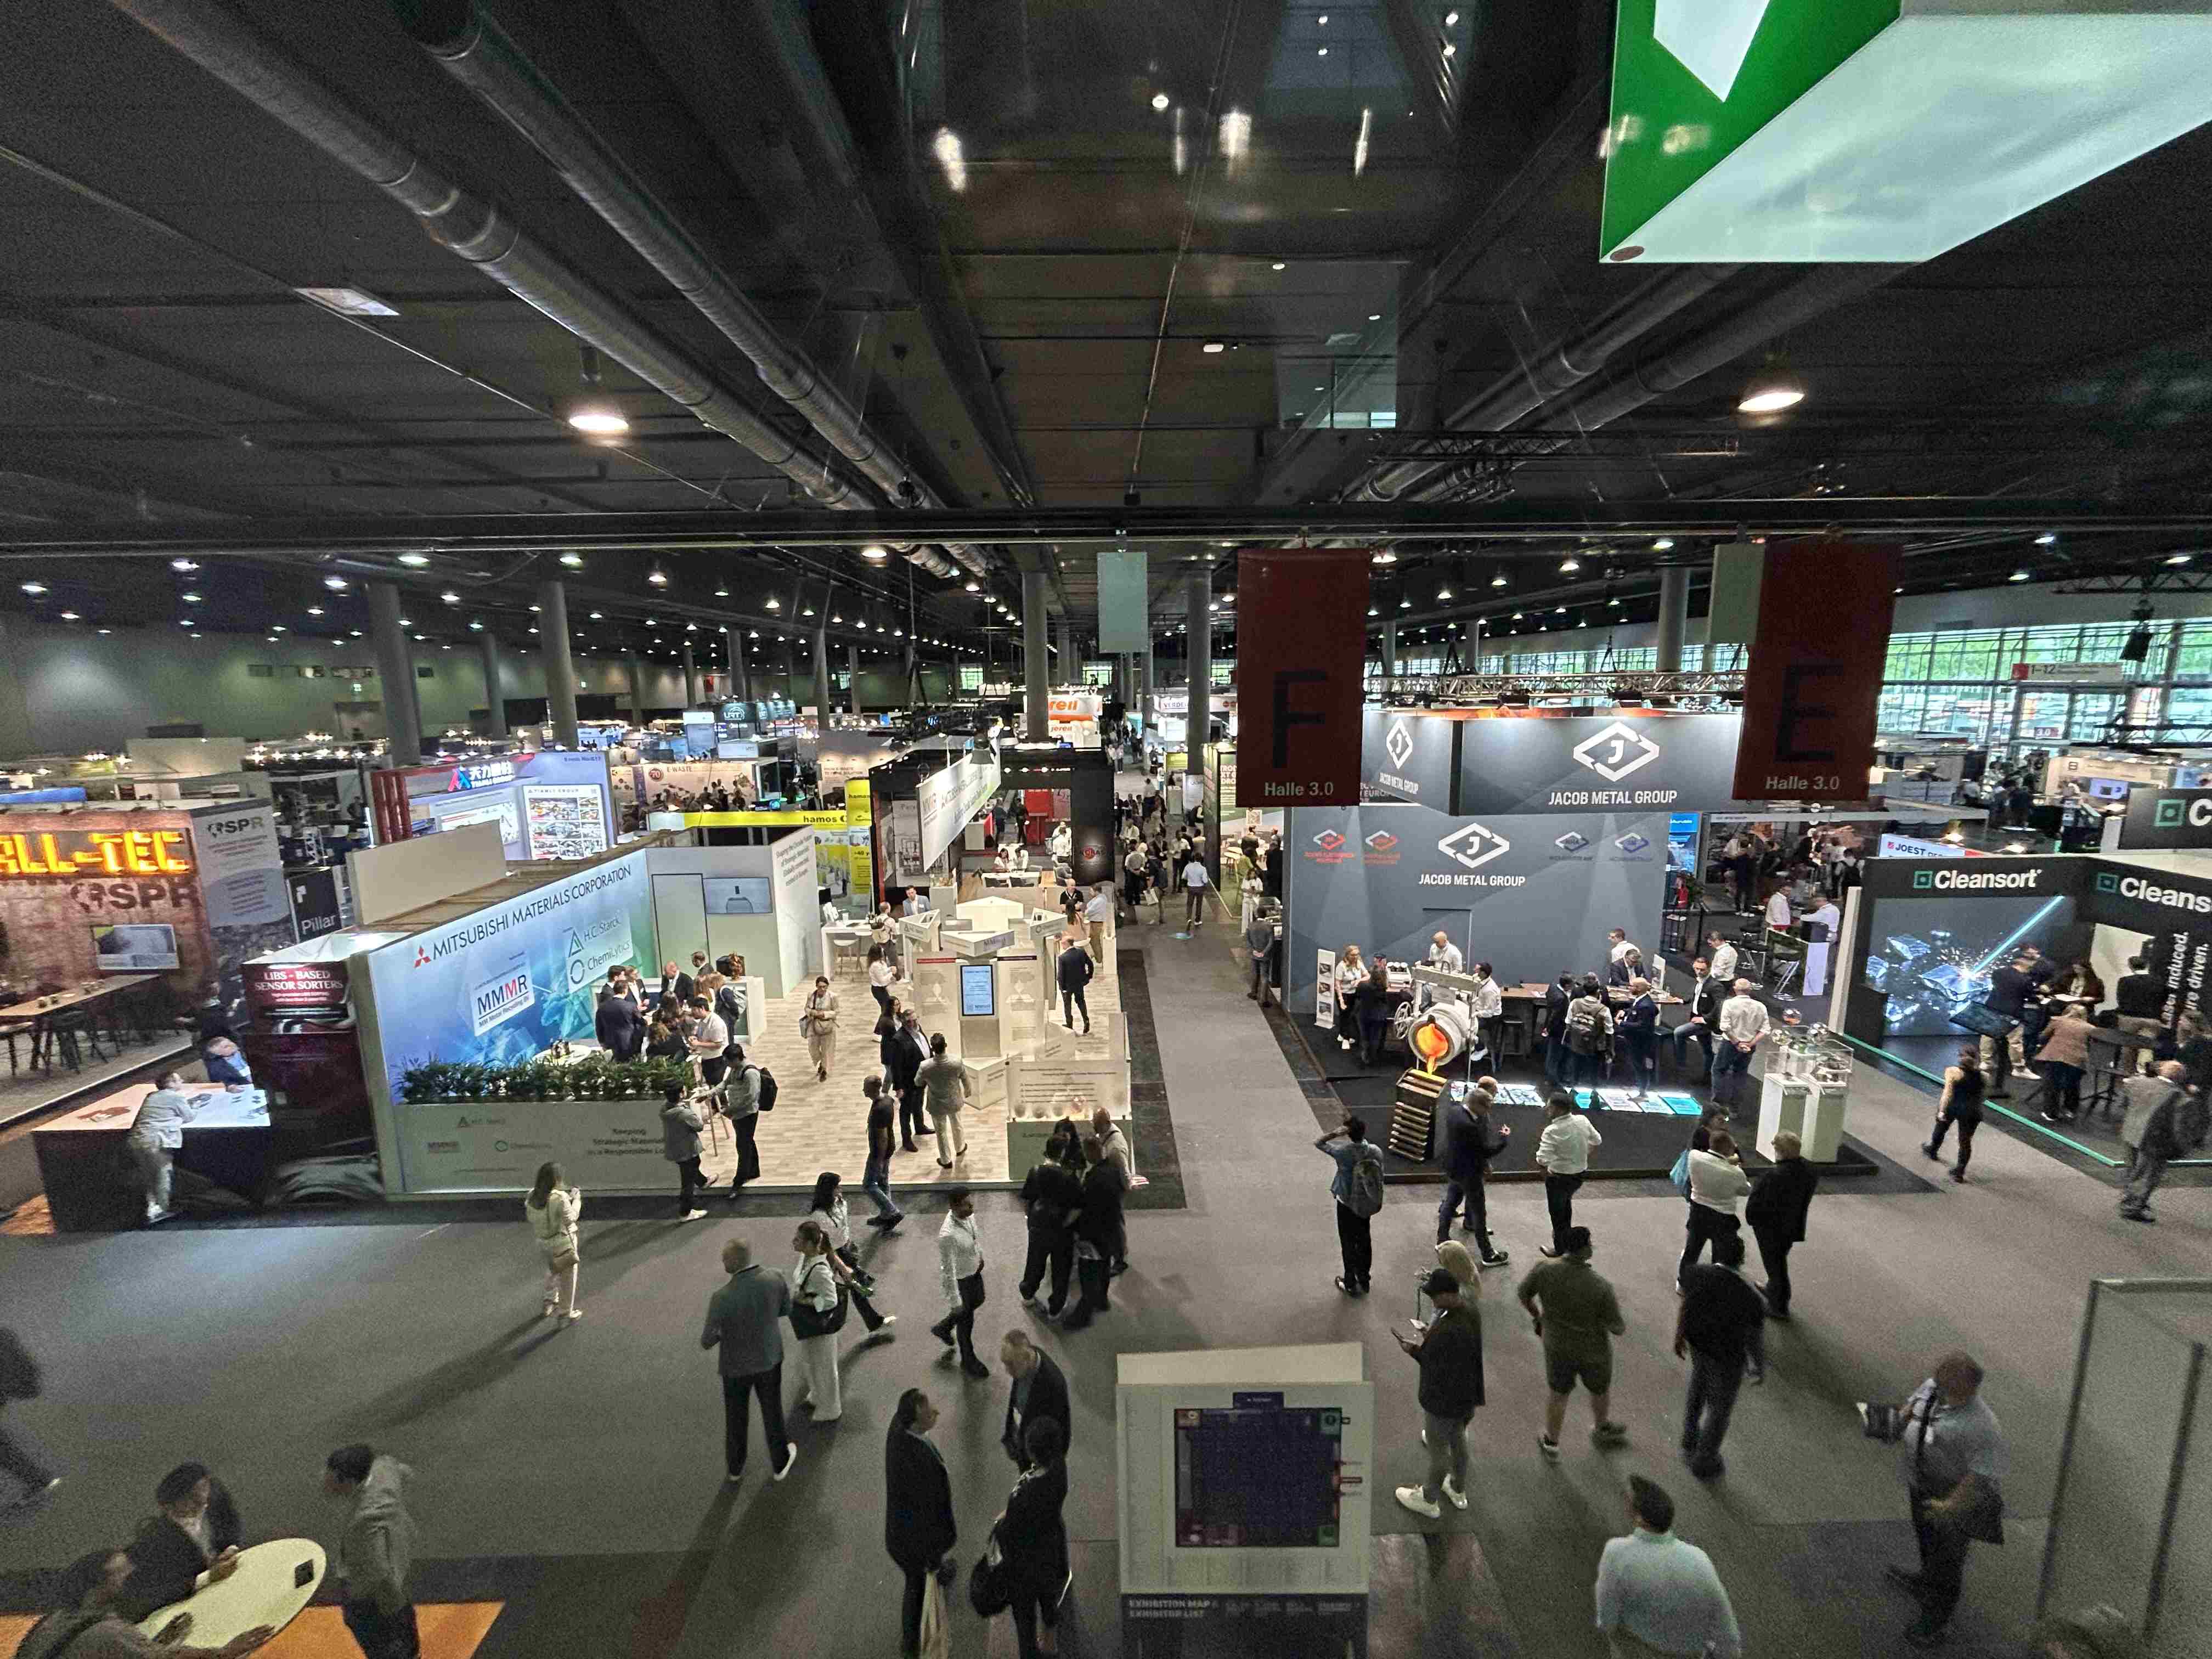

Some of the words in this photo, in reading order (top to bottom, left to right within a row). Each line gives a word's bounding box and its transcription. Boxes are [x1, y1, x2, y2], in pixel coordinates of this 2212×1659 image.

[1272, 669, 1327, 769] F
[1773, 661, 1844, 763] E
[1264, 781, 1304, 797] Halle
[1308, 781, 1334, 796] 3.0
[1379, 772, 1391, 786] JACOB
[1391, 776, 1403, 791] METAL
[1403, 780, 1419, 794] GROUP
[1765, 775, 1809, 791] Halle
[1812, 775, 1840, 790] 3.0
[1548, 792, 1589, 805] JACOB
[1591, 791, 1632, 805] METAL
[1635, 790, 1678, 804] GROUP
[803, 814, 838, 823] hamos
[1895, 844, 1926, 855] JOEST
[1419, 873, 1452, 885] JACOB
[1453, 874, 1488, 885] METAL
[1489, 875, 1526, 887] GROUP
[1934, 869, 2038, 889] Cleansort
[2119, 877, 2212, 913] Cleans
[432, 914, 509, 961] MITSUBISHI
[511, 889, 571, 927] MATERIALS
[572, 864, 631, 900] CORPORATION
[302, 914, 336, 935] Pillar
[263, 970, 286, 980] LIBS
[294, 969, 331, 980] BASED
[2187, 943, 2210, 989] driven.
[255, 980, 296, 991] SENSOR
[297, 980, 343, 990] SORTERS
[477, 974, 528, 1015] MMMR
